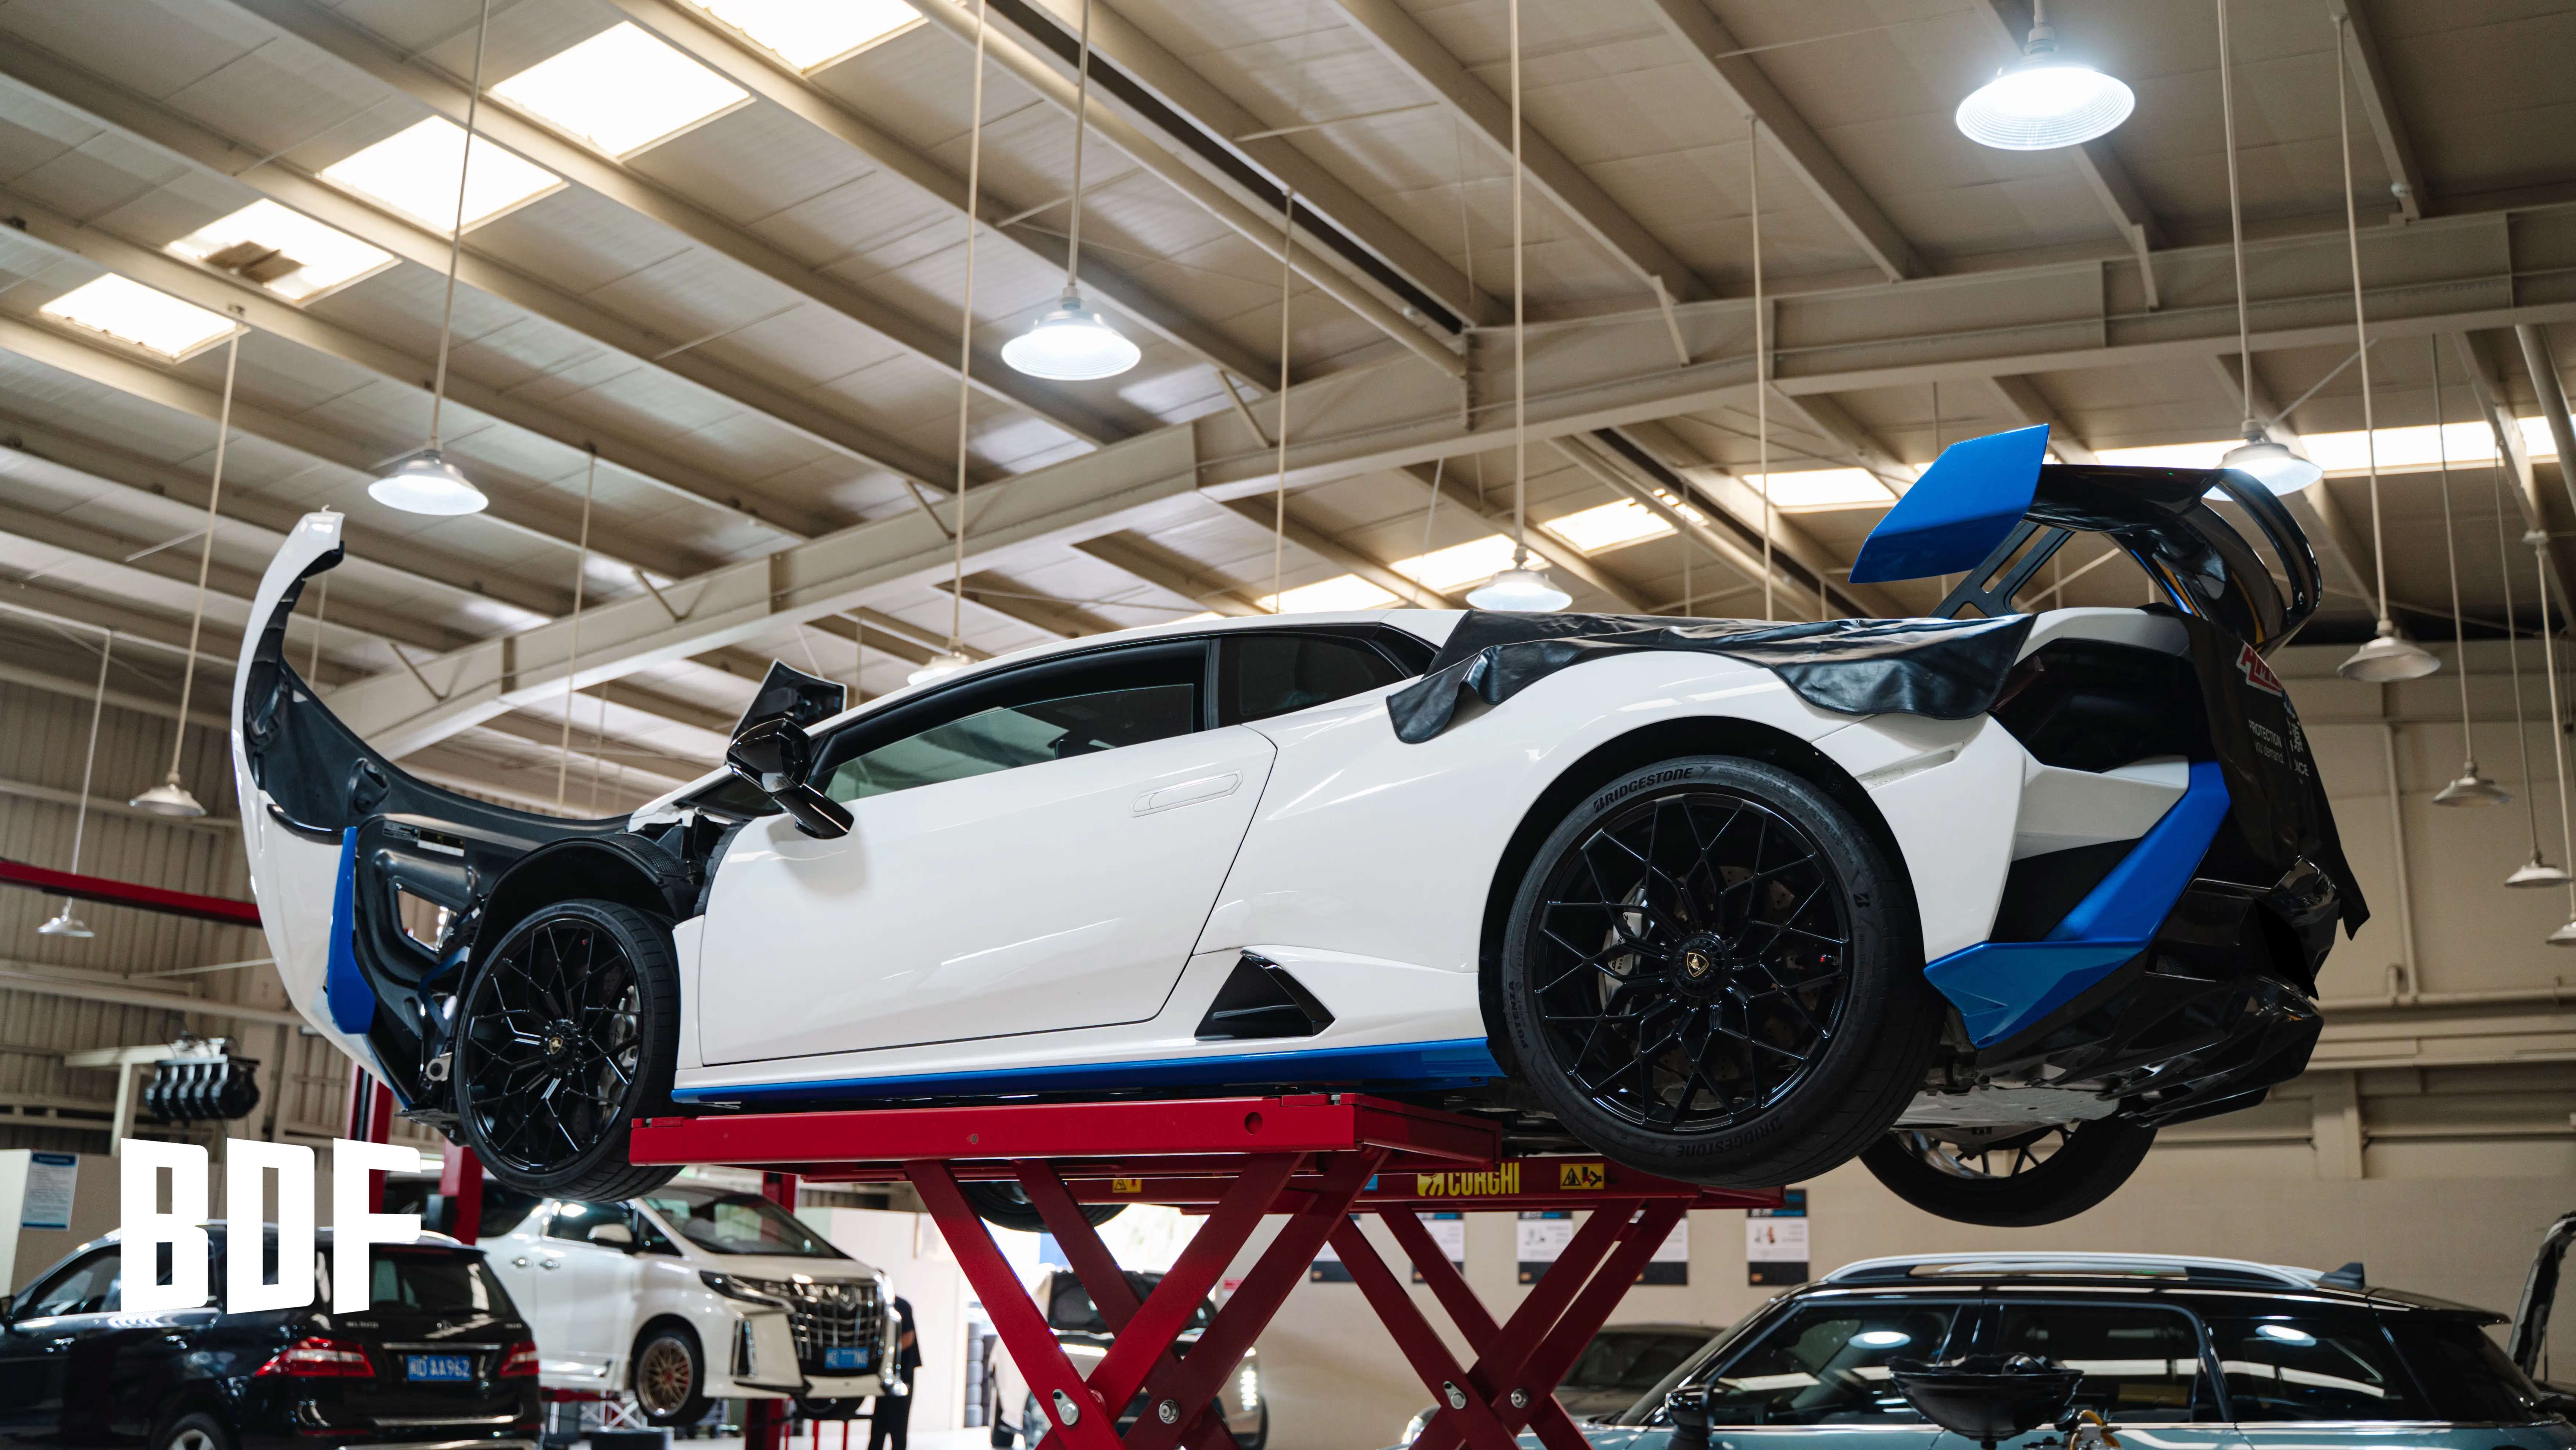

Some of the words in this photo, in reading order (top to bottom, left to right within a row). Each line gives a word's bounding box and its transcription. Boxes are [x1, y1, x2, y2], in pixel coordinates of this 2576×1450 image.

[2248, 719, 2282, 748] PROTECTION
[1593, 768, 1693, 813] BRIDGESTONE
[1509, 981, 1528, 1048] POTENZA
[1675, 1115, 1783, 1157] BRIDGESTONE
[1448, 1162, 1520, 1196] CORGHI
